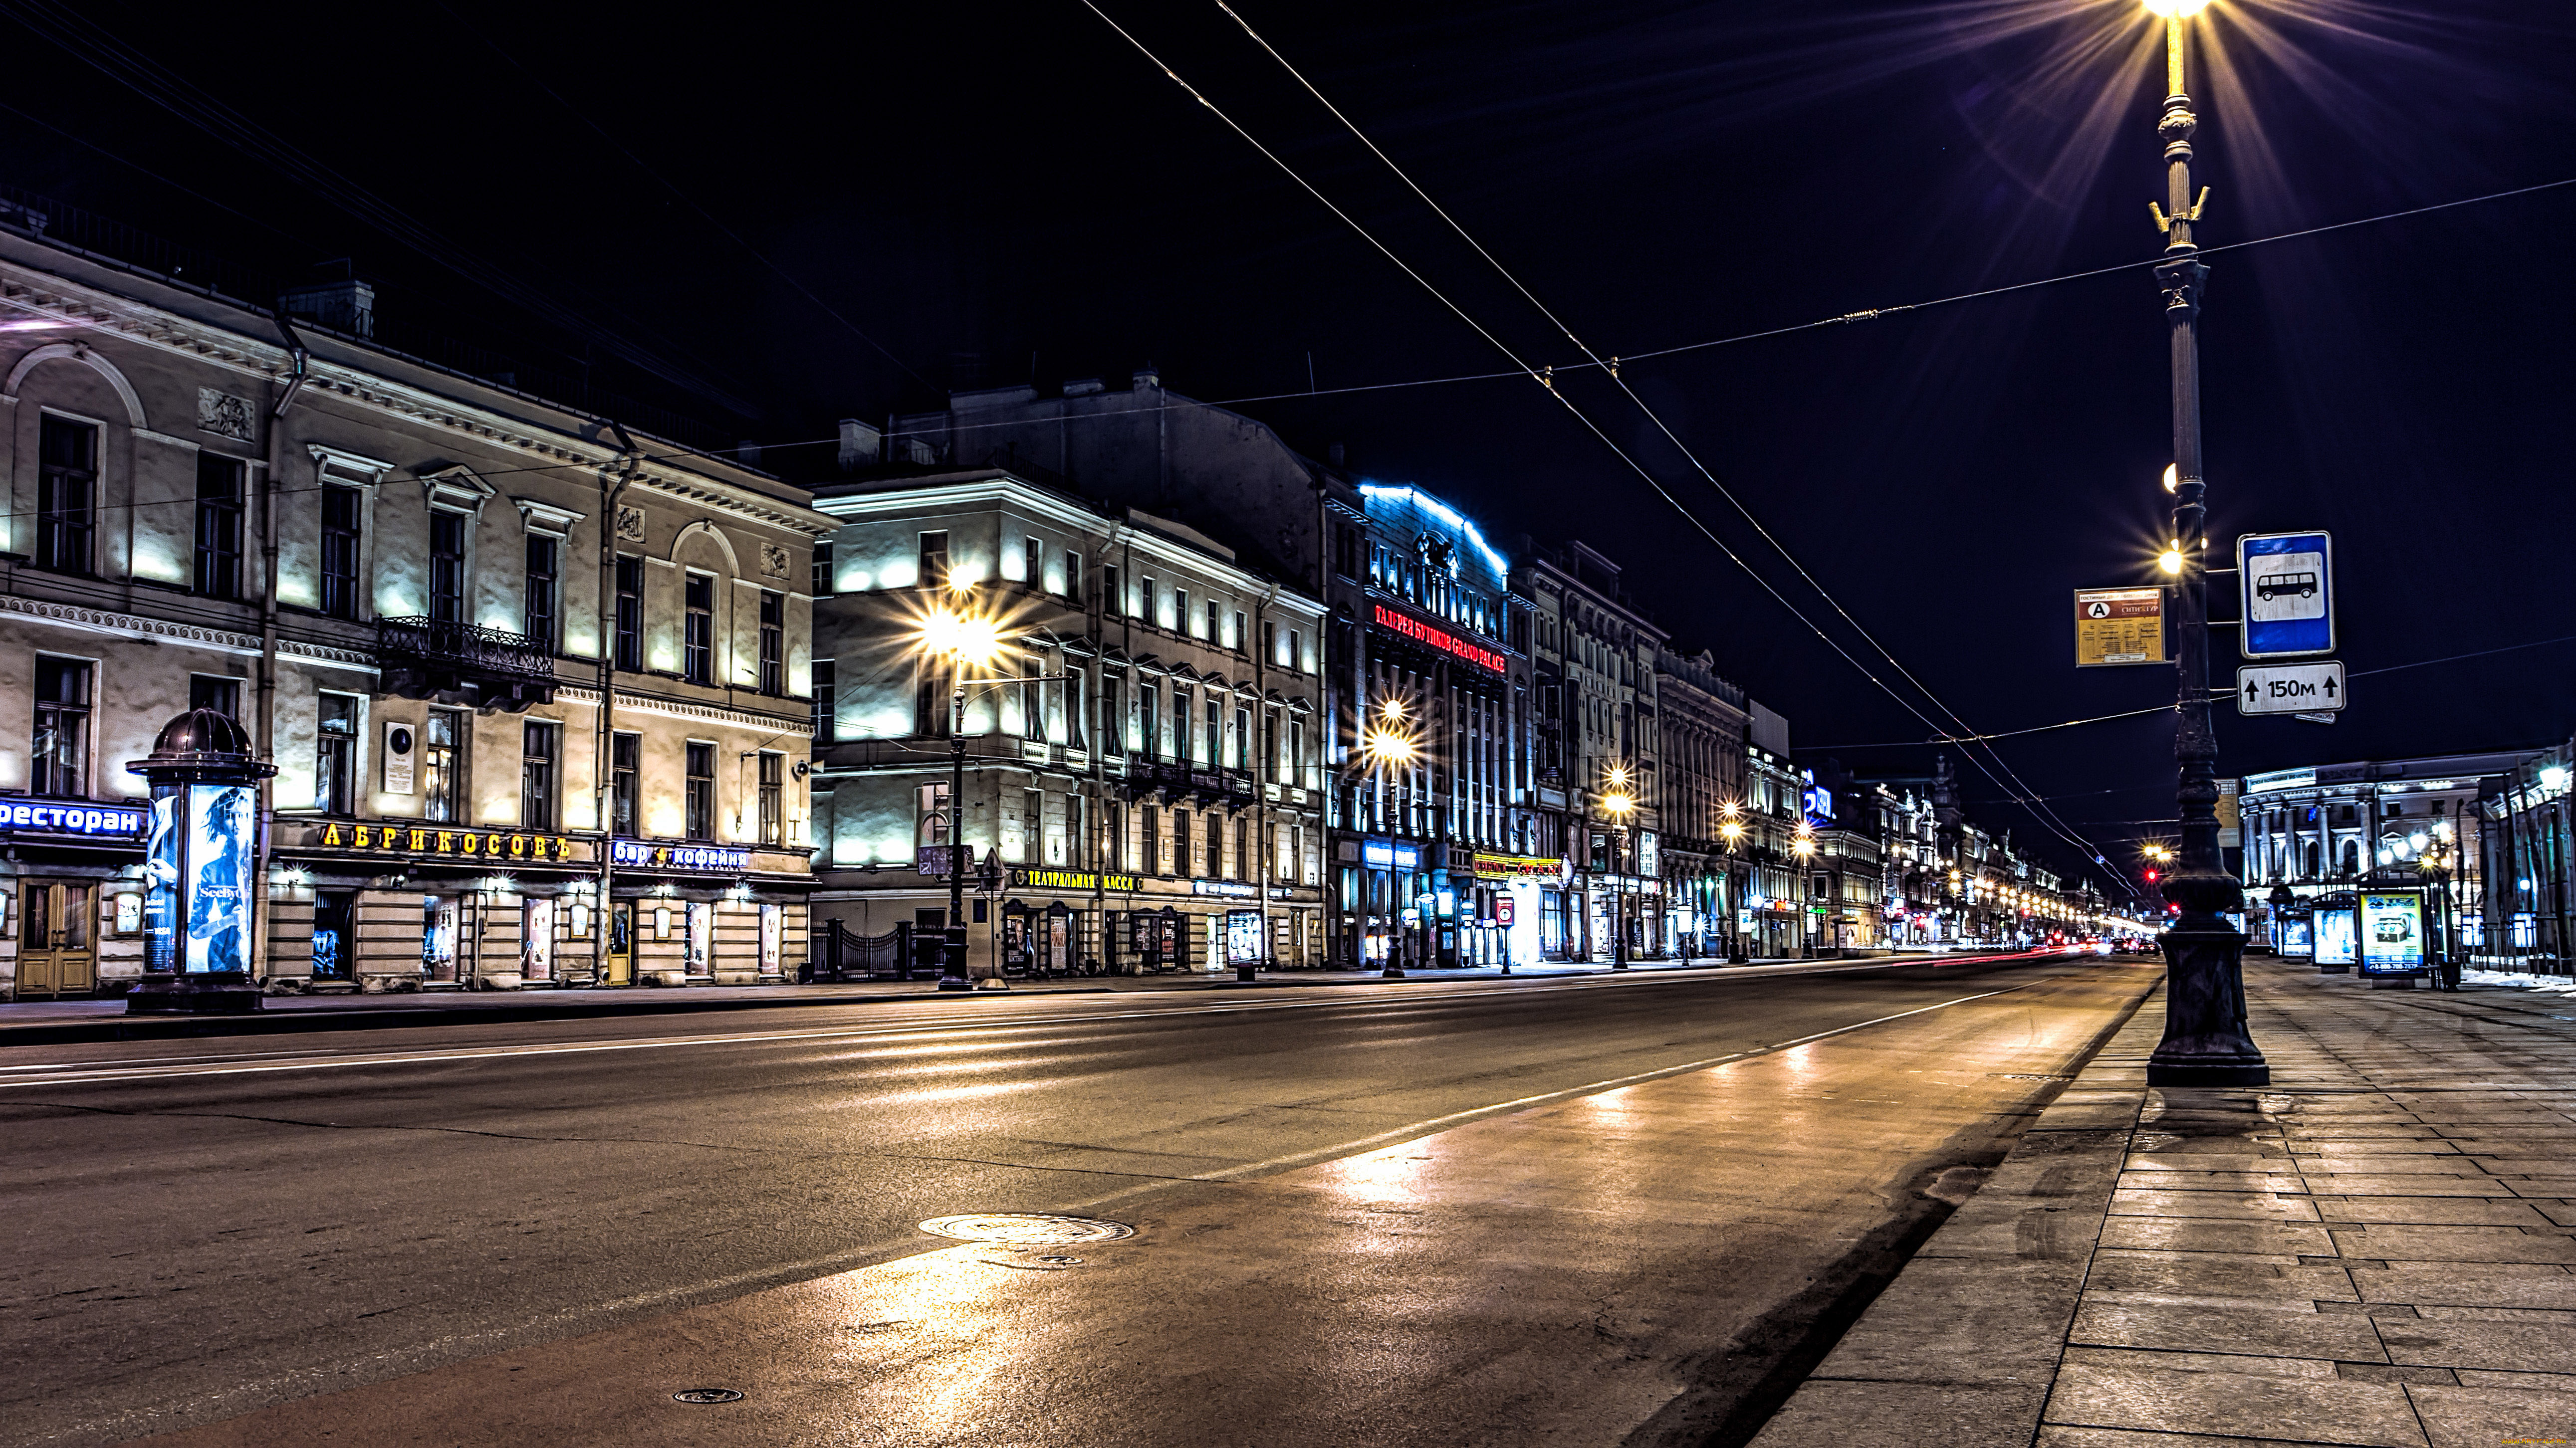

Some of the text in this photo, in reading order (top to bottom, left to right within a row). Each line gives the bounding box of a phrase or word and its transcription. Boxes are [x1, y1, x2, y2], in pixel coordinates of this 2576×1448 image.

[1376, 605, 1505, 673] ГАЛЕРЕЯ БУТИКОВ GRAND PALACE
[324, 823, 570, 856] АБРИКОСОВЪ
[615, 841, 747, 866] бар кофейня
[1028, 870, 1095, 888] ТЕАТРАЛЬНАЯ
